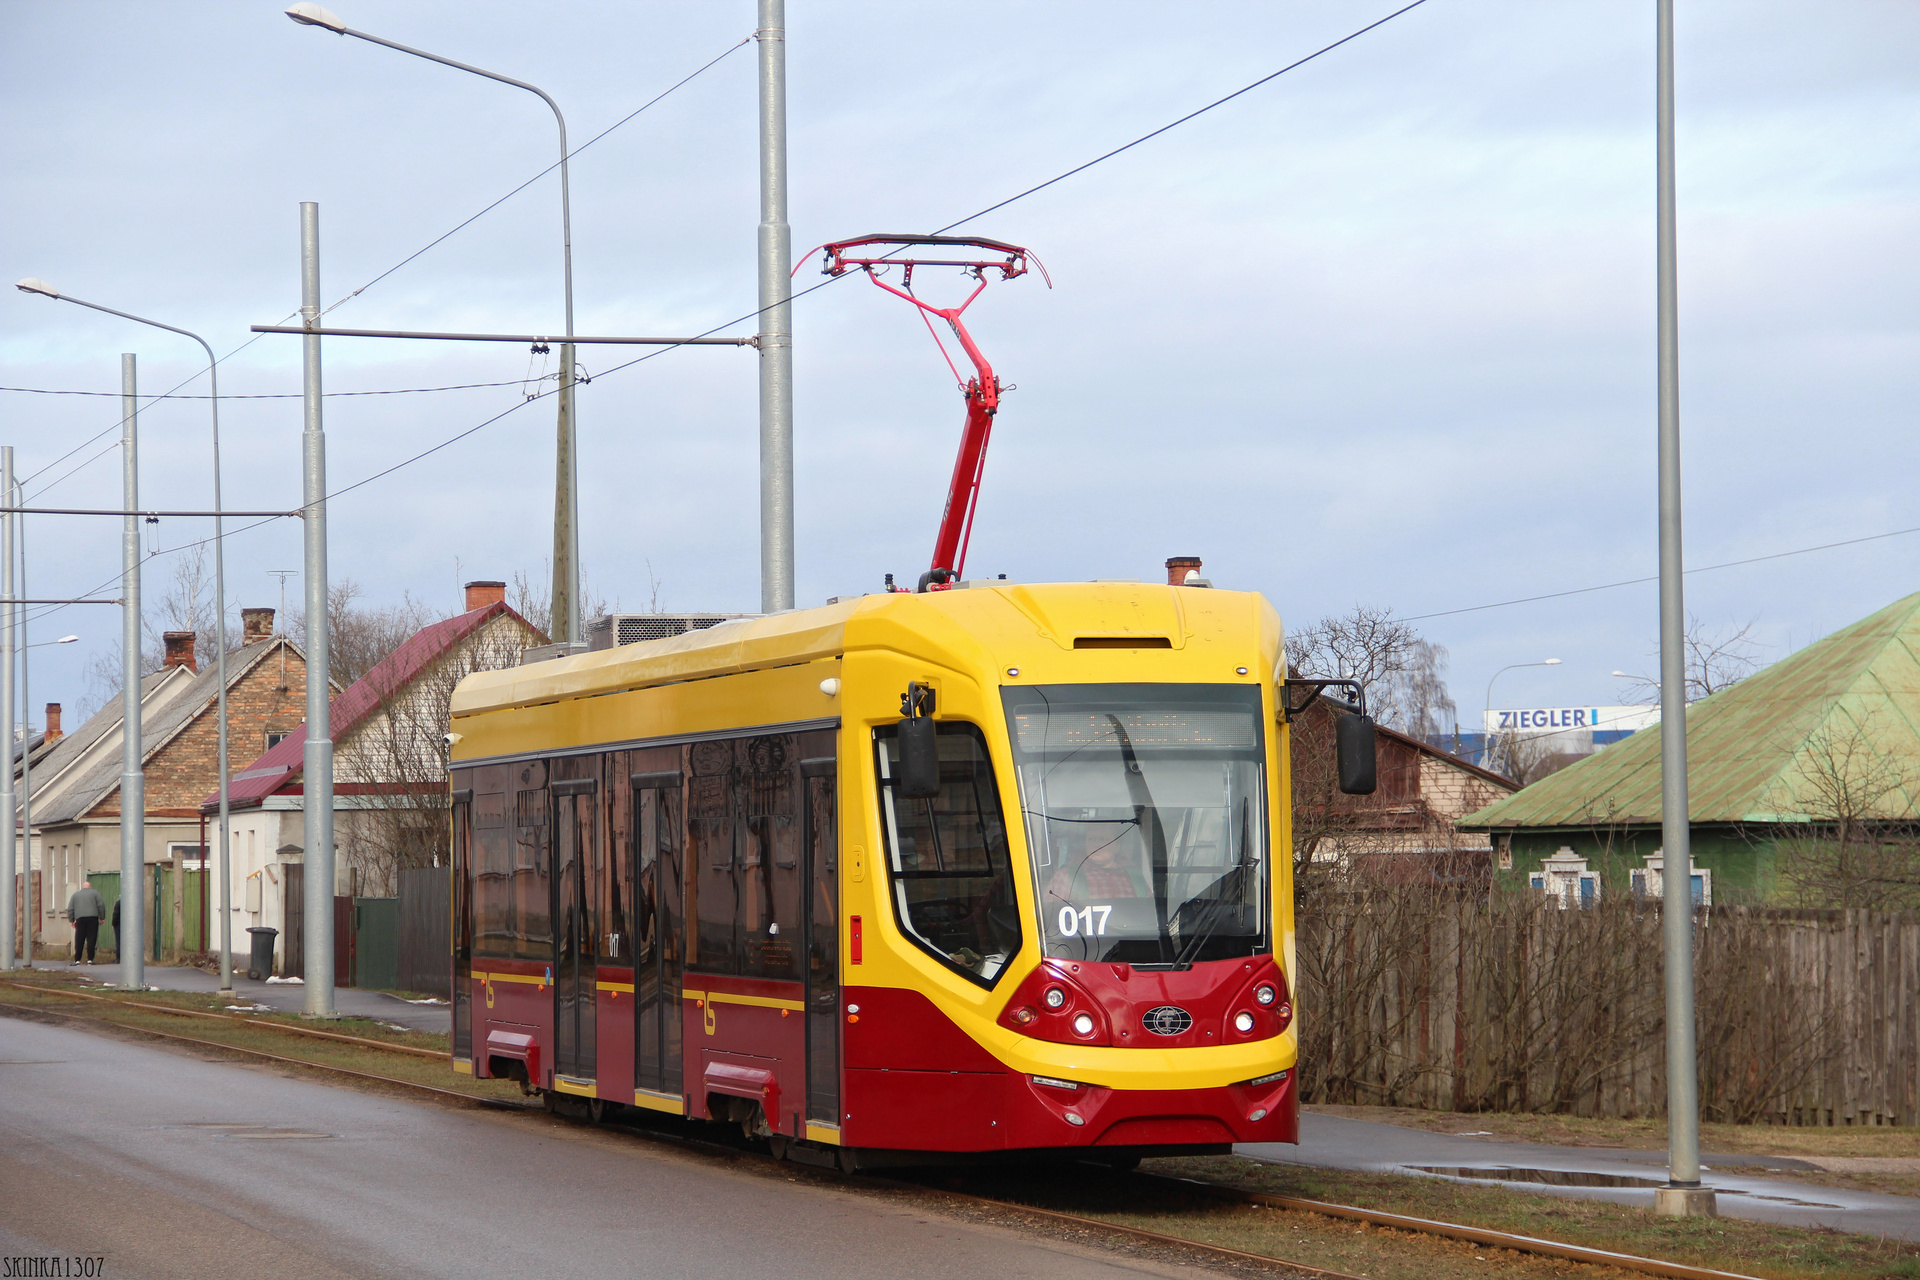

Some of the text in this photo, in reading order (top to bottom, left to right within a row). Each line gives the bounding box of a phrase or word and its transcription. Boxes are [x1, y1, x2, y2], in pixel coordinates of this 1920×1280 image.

[1499, 709, 1586, 729] ZIEGLER
[1058, 905, 1112, 937] 017
[609, 932, 619, 958] 017
